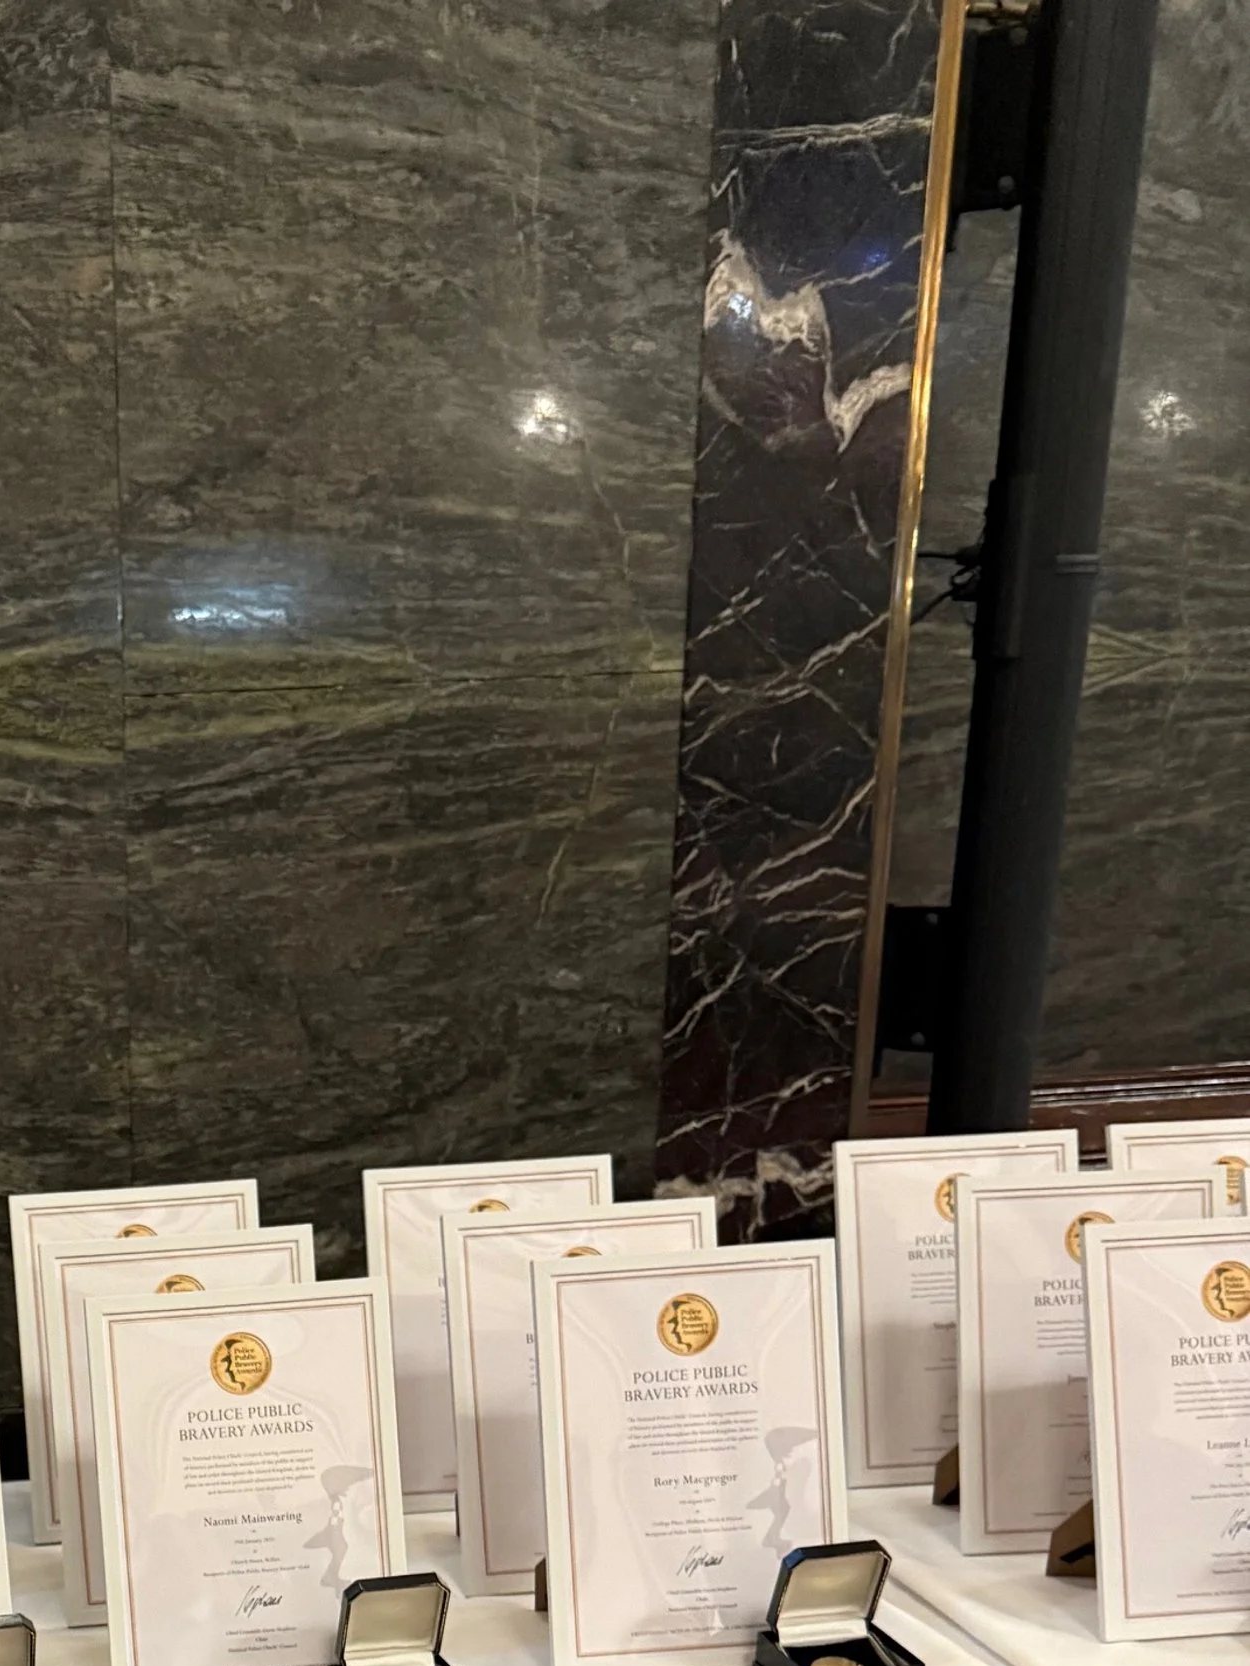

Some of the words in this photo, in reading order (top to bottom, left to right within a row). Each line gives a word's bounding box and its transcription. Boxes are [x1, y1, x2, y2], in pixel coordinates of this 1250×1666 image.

[915, 1234, 954, 1247] POLIC
[907, 1248, 957, 1261] BRAVER
[1043, 1279, 1083, 1291] POLIC
[1178, 1334, 1233, 1349] POLICE
[1171, 1352, 1233, 1367] BRAVERY
[633, 1369, 688, 1384] POLICE
[693, 1364, 748, 1380] PUBLIC
[624, 1385, 691, 1402] BRAVERY
[695, 1381, 758, 1397] AWARDS
[188, 1407, 244, 1423] POLICE
[248, 1402, 302, 1419] PUBLIC
[179, 1424, 246, 1441] BRAVERY
[250, 1419, 314, 1436] AWARDS
[653, 1476, 681, 1489] Rory
[683, 1473, 738, 1487] Macgregor
[203, 1516, 238, 1528] Naomi
[241, 1511, 303, 1525] Mainwaring
